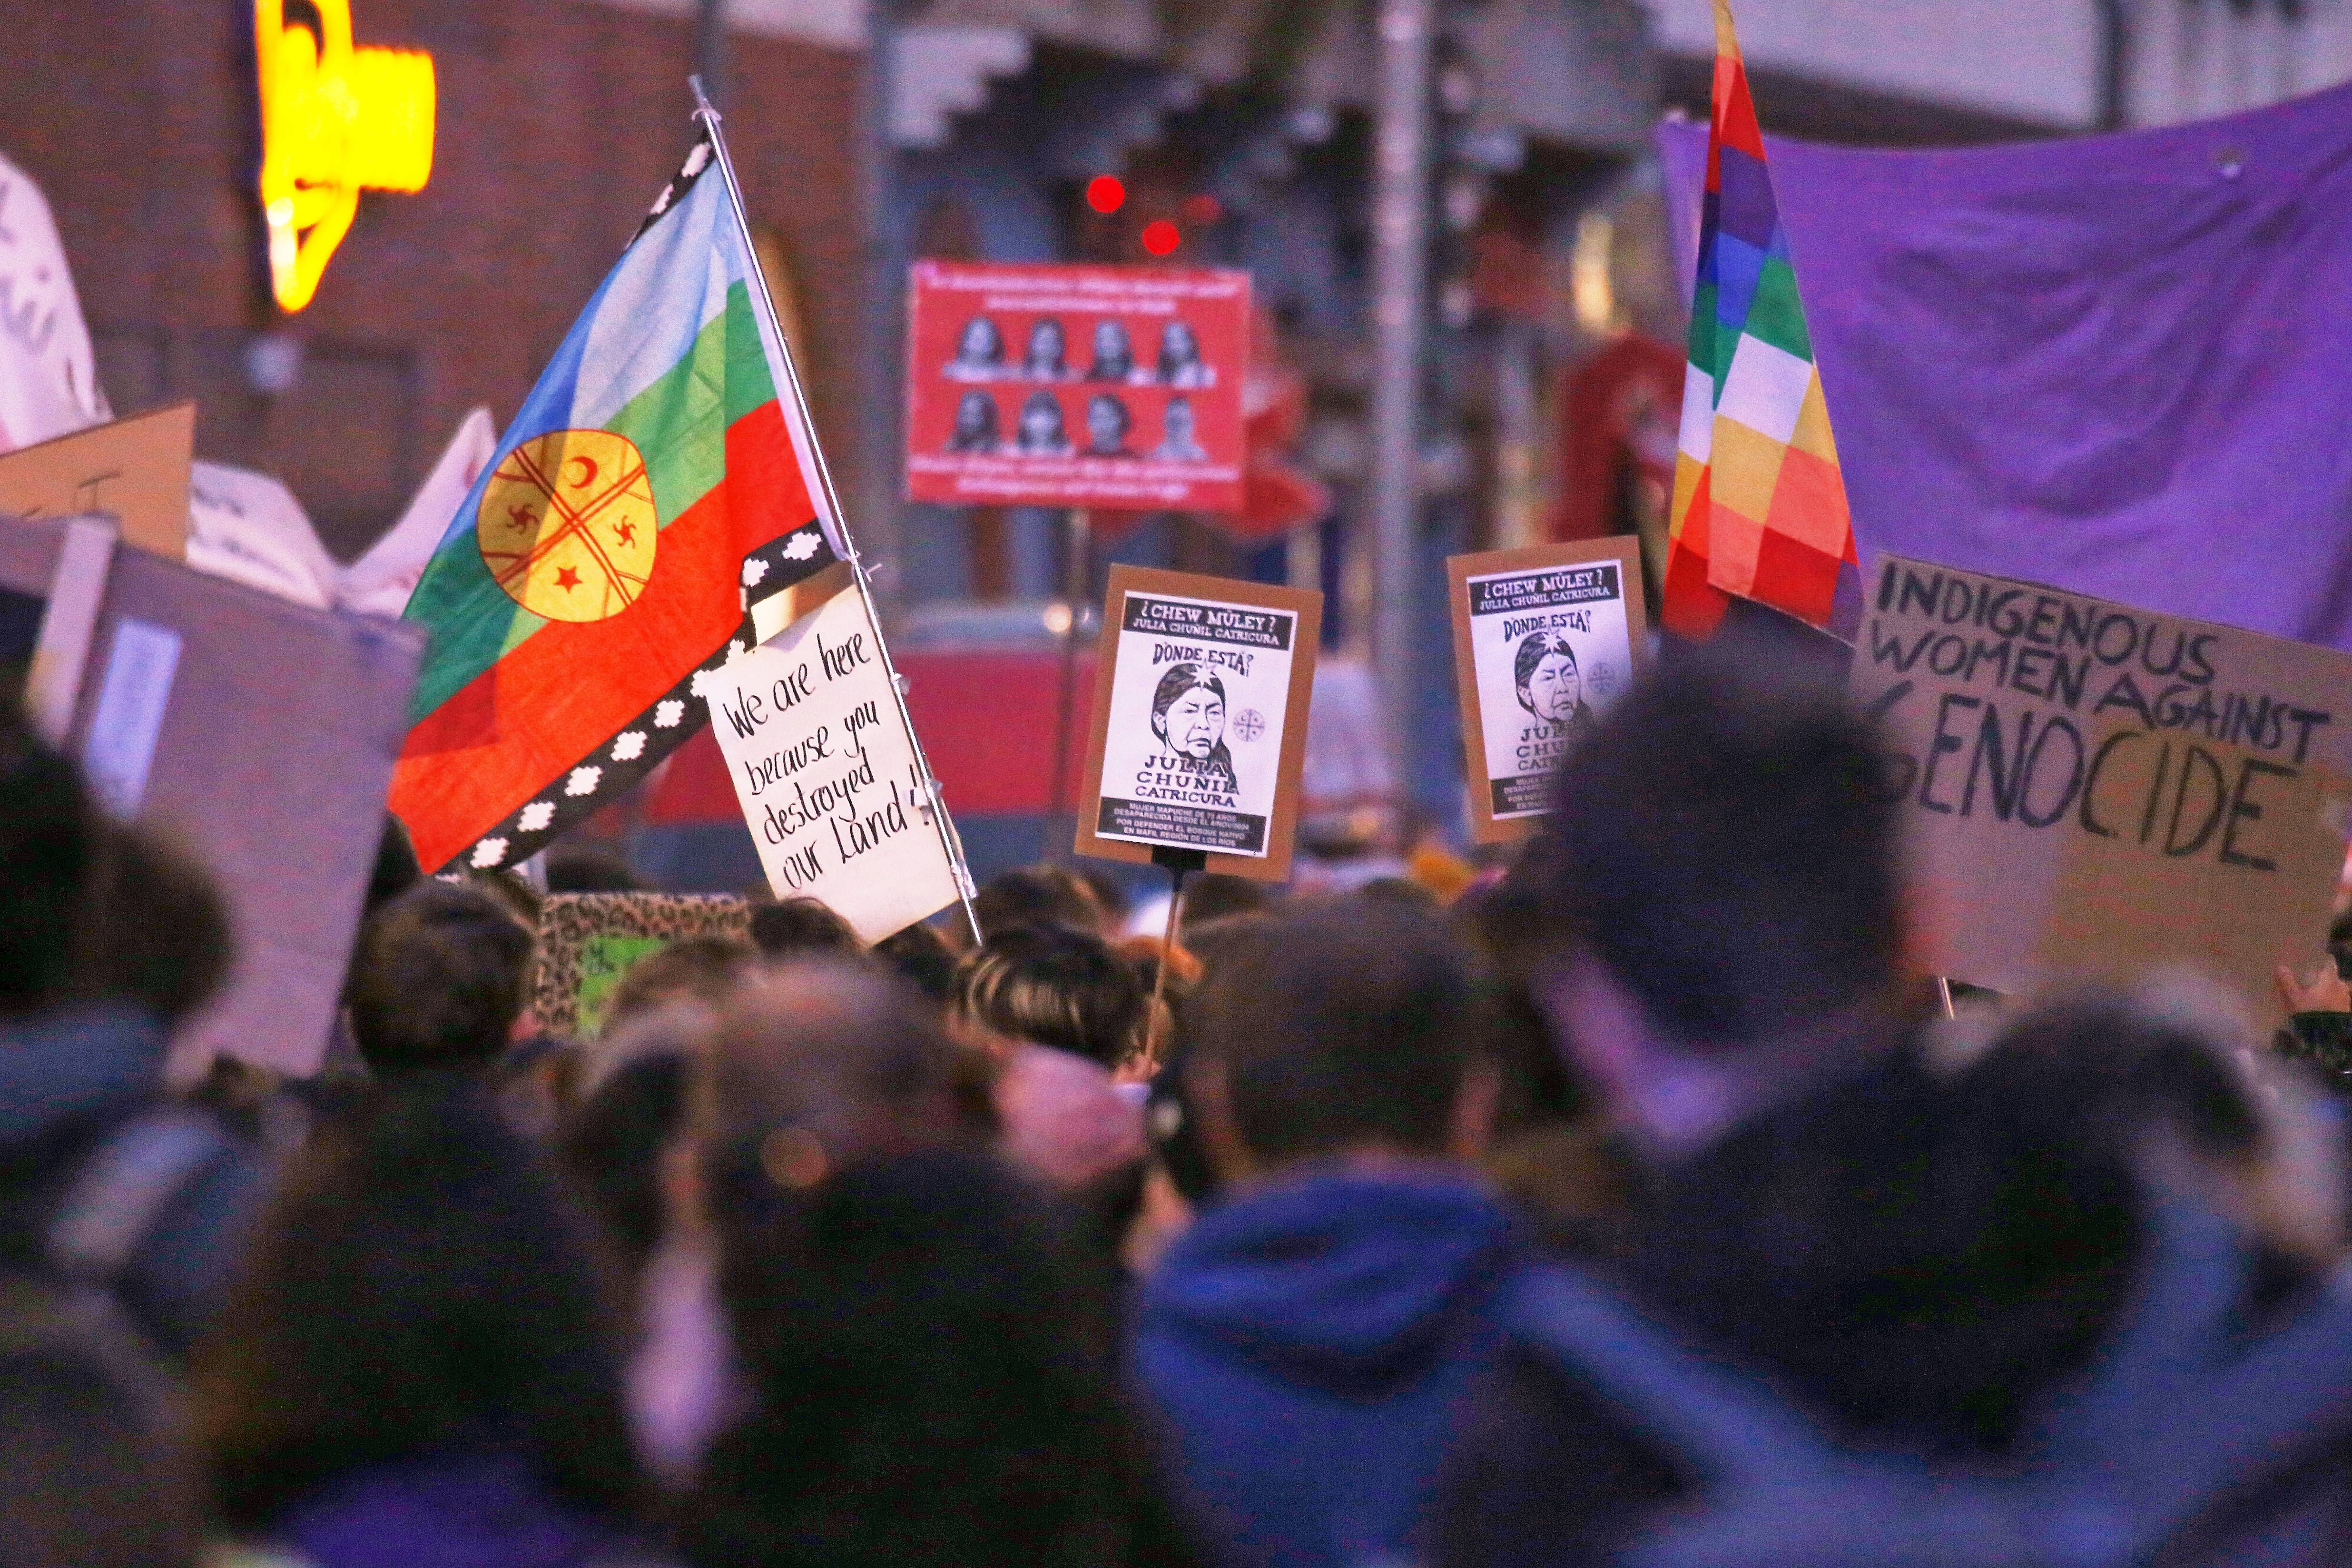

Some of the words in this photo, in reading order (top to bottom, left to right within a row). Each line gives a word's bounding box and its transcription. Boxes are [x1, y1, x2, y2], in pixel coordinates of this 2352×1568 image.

[1480, 599, 1509, 611] JULIA
[1551, 585, 1610, 602] CATRICURA
[1132, 618, 1167, 631] JULIA
[1214, 628, 1280, 645] CATRICURA
[1878, 562, 2219, 685] INDIGENOUS
[722, 687, 769, 740] We
[772, 663, 815, 712] are
[816, 633, 871, 681] here
[1871, 620, 2091, 710] WOMEN
[2094, 673, 2331, 761] AGAINST
[744, 725, 835, 796] because
[844, 700, 880, 758] you
[1144, 755, 1228, 777] JULIA
[764, 746, 876, 845] destroyed
[1135, 786, 1236, 807] CATRICURA
[1114, 808, 1172, 821] DESAPARECIDA
[1172, 815, 1198, 824] DESDE
[1156, 806, 1193, 817] MAPUCHE
[1133, 820, 1174, 831] DEFENDER
[1186, 827, 1217, 836] BOSQUE
[1201, 836, 1217, 844] LOS
[783, 839, 823, 890] our
